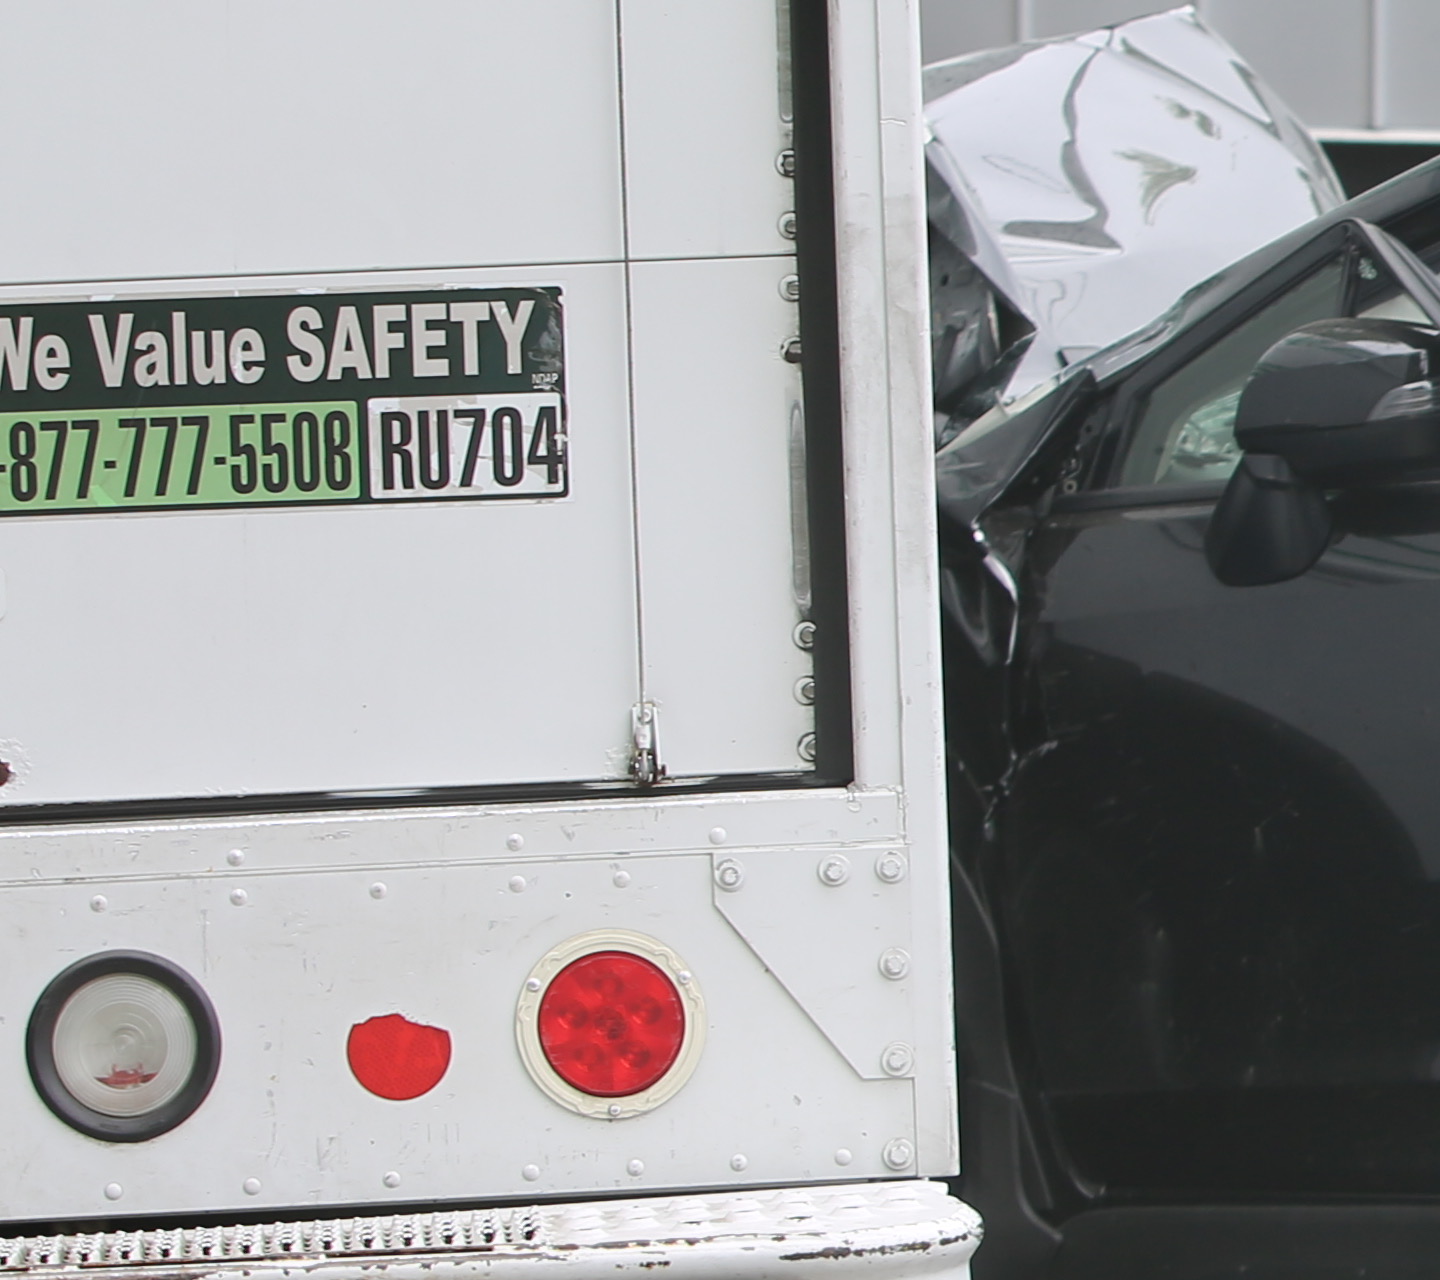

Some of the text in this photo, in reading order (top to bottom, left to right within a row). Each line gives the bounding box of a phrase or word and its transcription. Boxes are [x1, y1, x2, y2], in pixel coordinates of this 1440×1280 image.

[89, 310, 267, 388] Value
[286, 300, 535, 383] SAFETY
[380, 405, 564, 491] RU704
